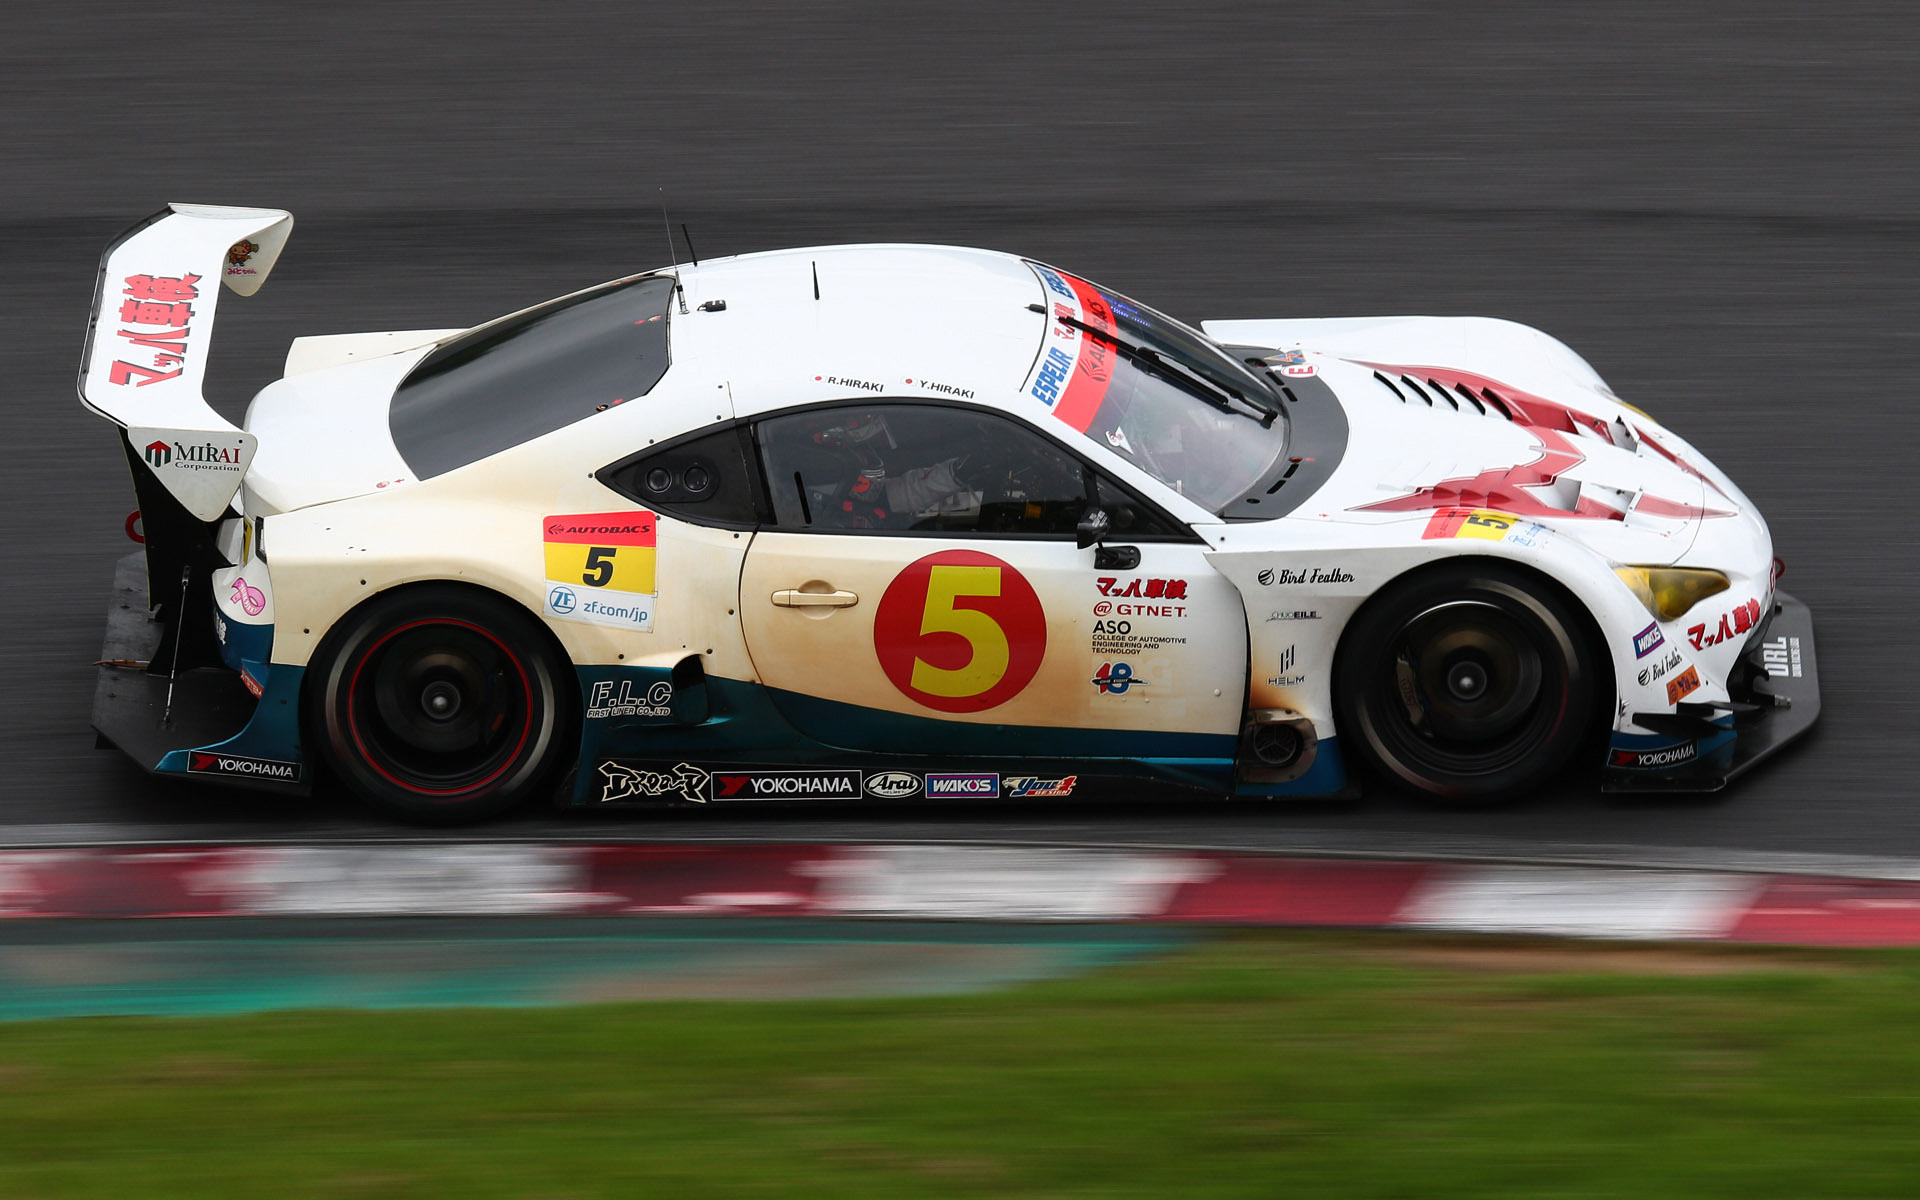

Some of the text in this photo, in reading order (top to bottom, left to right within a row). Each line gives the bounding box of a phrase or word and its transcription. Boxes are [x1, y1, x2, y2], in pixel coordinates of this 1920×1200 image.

[109, 272, 203, 388] マッハ車検
[827, 376, 884, 393] R.HIRAKI
[1031, 346, 1074, 407] ESPELIR
[919, 380, 975, 399] Y.HIRAKI
[175, 444, 241, 463] MIRAI
[174, 461, 240, 471] Corporation
[567, 525, 651, 533] AUTOBACS
[582, 546, 617, 587] 5
[1279, 568, 1355, 585] Bird Feather
[1096, 577, 1188, 600] マッハ車検
[552, 589, 648, 622] ZF zf.com/jp
[910, 565, 1010, 698] 5
[1093, 620, 1131, 634] ASO
[1092, 634, 1126, 642] COLLEGE
[1139, 636, 1187, 644] AUTOMOTIVE
[1092, 641, 1142, 649] ENGINEERING
[1268, 676, 1305, 686] HELM
[587, 708, 611, 718] FIRST
[611, 706, 635, 716] LINER
[1638, 744, 1696, 766] YOKOHAMA
[218, 758, 295, 778] YOKOHAMA
[750, 777, 853, 794] YOKOHAMA
[867, 775, 917, 791] Arai
